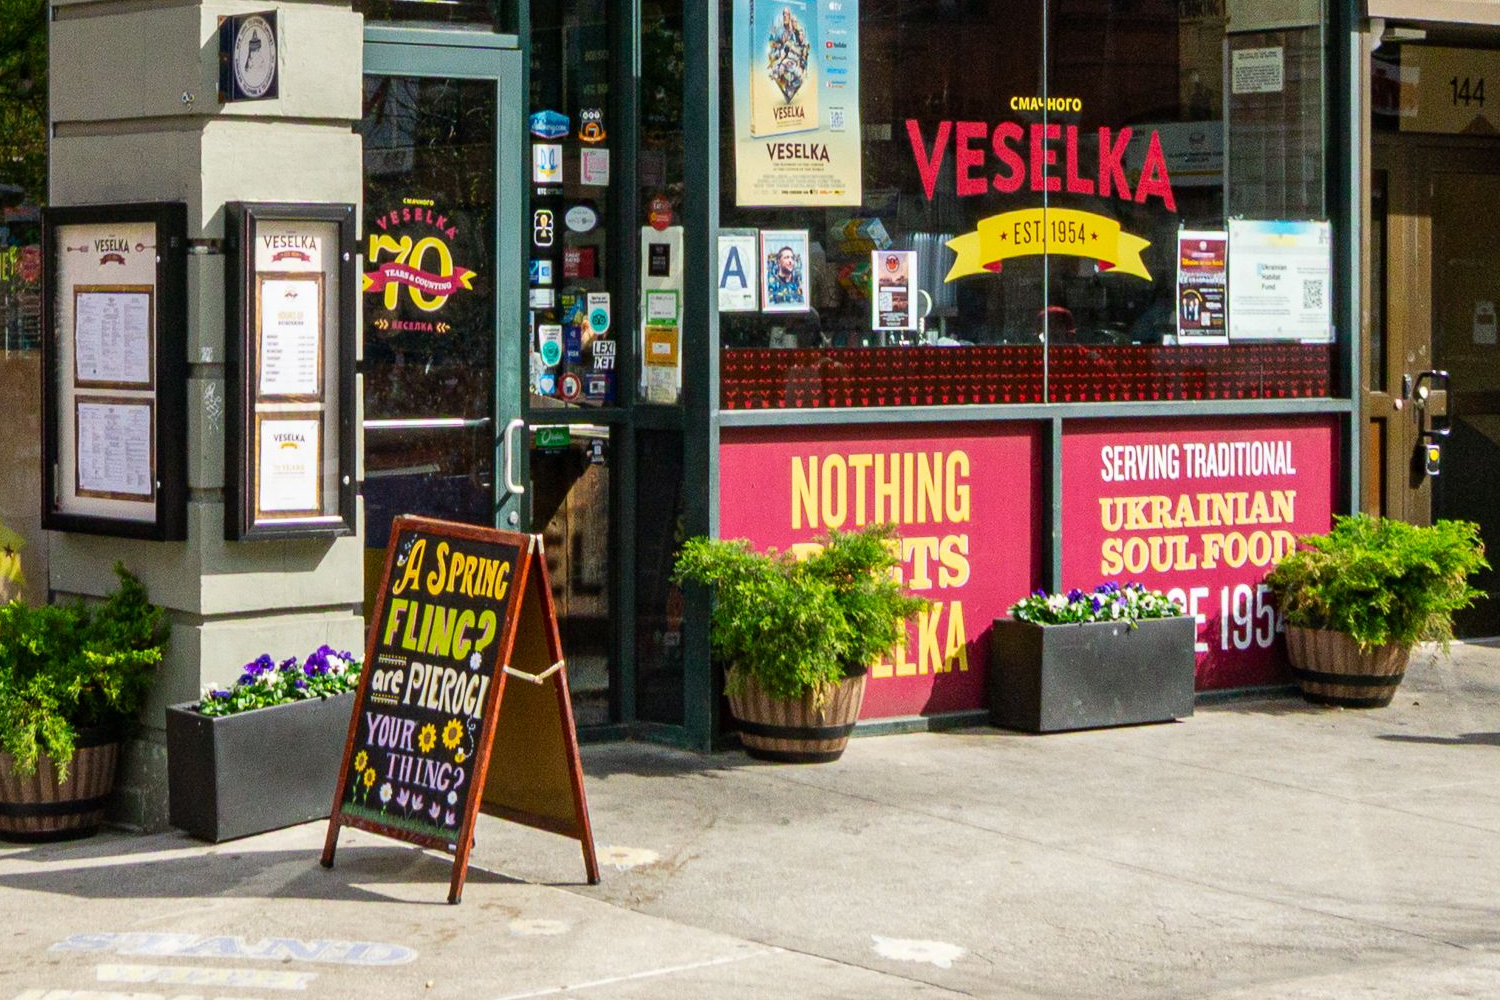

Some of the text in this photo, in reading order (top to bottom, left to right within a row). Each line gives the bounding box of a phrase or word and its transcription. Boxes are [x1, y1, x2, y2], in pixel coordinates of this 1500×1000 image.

[1450, 76, 1485, 107] 144
[773, 105, 805, 120] VESELKA
[766, 143, 831, 163] VESELKA
[905, 119, 1177, 212] VESELKA
[264, 235, 316, 250] VESELKA
[376, 207, 458, 240] VESELKA
[1014, 221, 1086, 245] EST. 1954
[95, 240, 129, 253] VESELKA
[369, 234, 453, 311] 70
[384, 268, 409, 281] YEARS
[415, 276, 453, 290] COUNTING
[720, 246, 748, 288] A
[594, 341, 615, 355] LEXI
[274, 433, 305, 442] VESELKA
[1101, 441, 1296, 482] SERVING TRADITIONAL
[791, 450, 970, 529] NOTHING
[1099, 490, 1296, 531] UKRAINIAN
[393, 539, 510, 600] A SPRING
[1102, 530, 1296, 575] SOUL FOOD
[384, 598, 497, 661] FLING?
[1221, 583, 1286, 651] 195
[372, 662, 490, 719] are PIEROGI
[366, 712, 416, 751] YOUR
[386, 752, 465, 791] THING?
[52, 932, 417, 966] STAND
